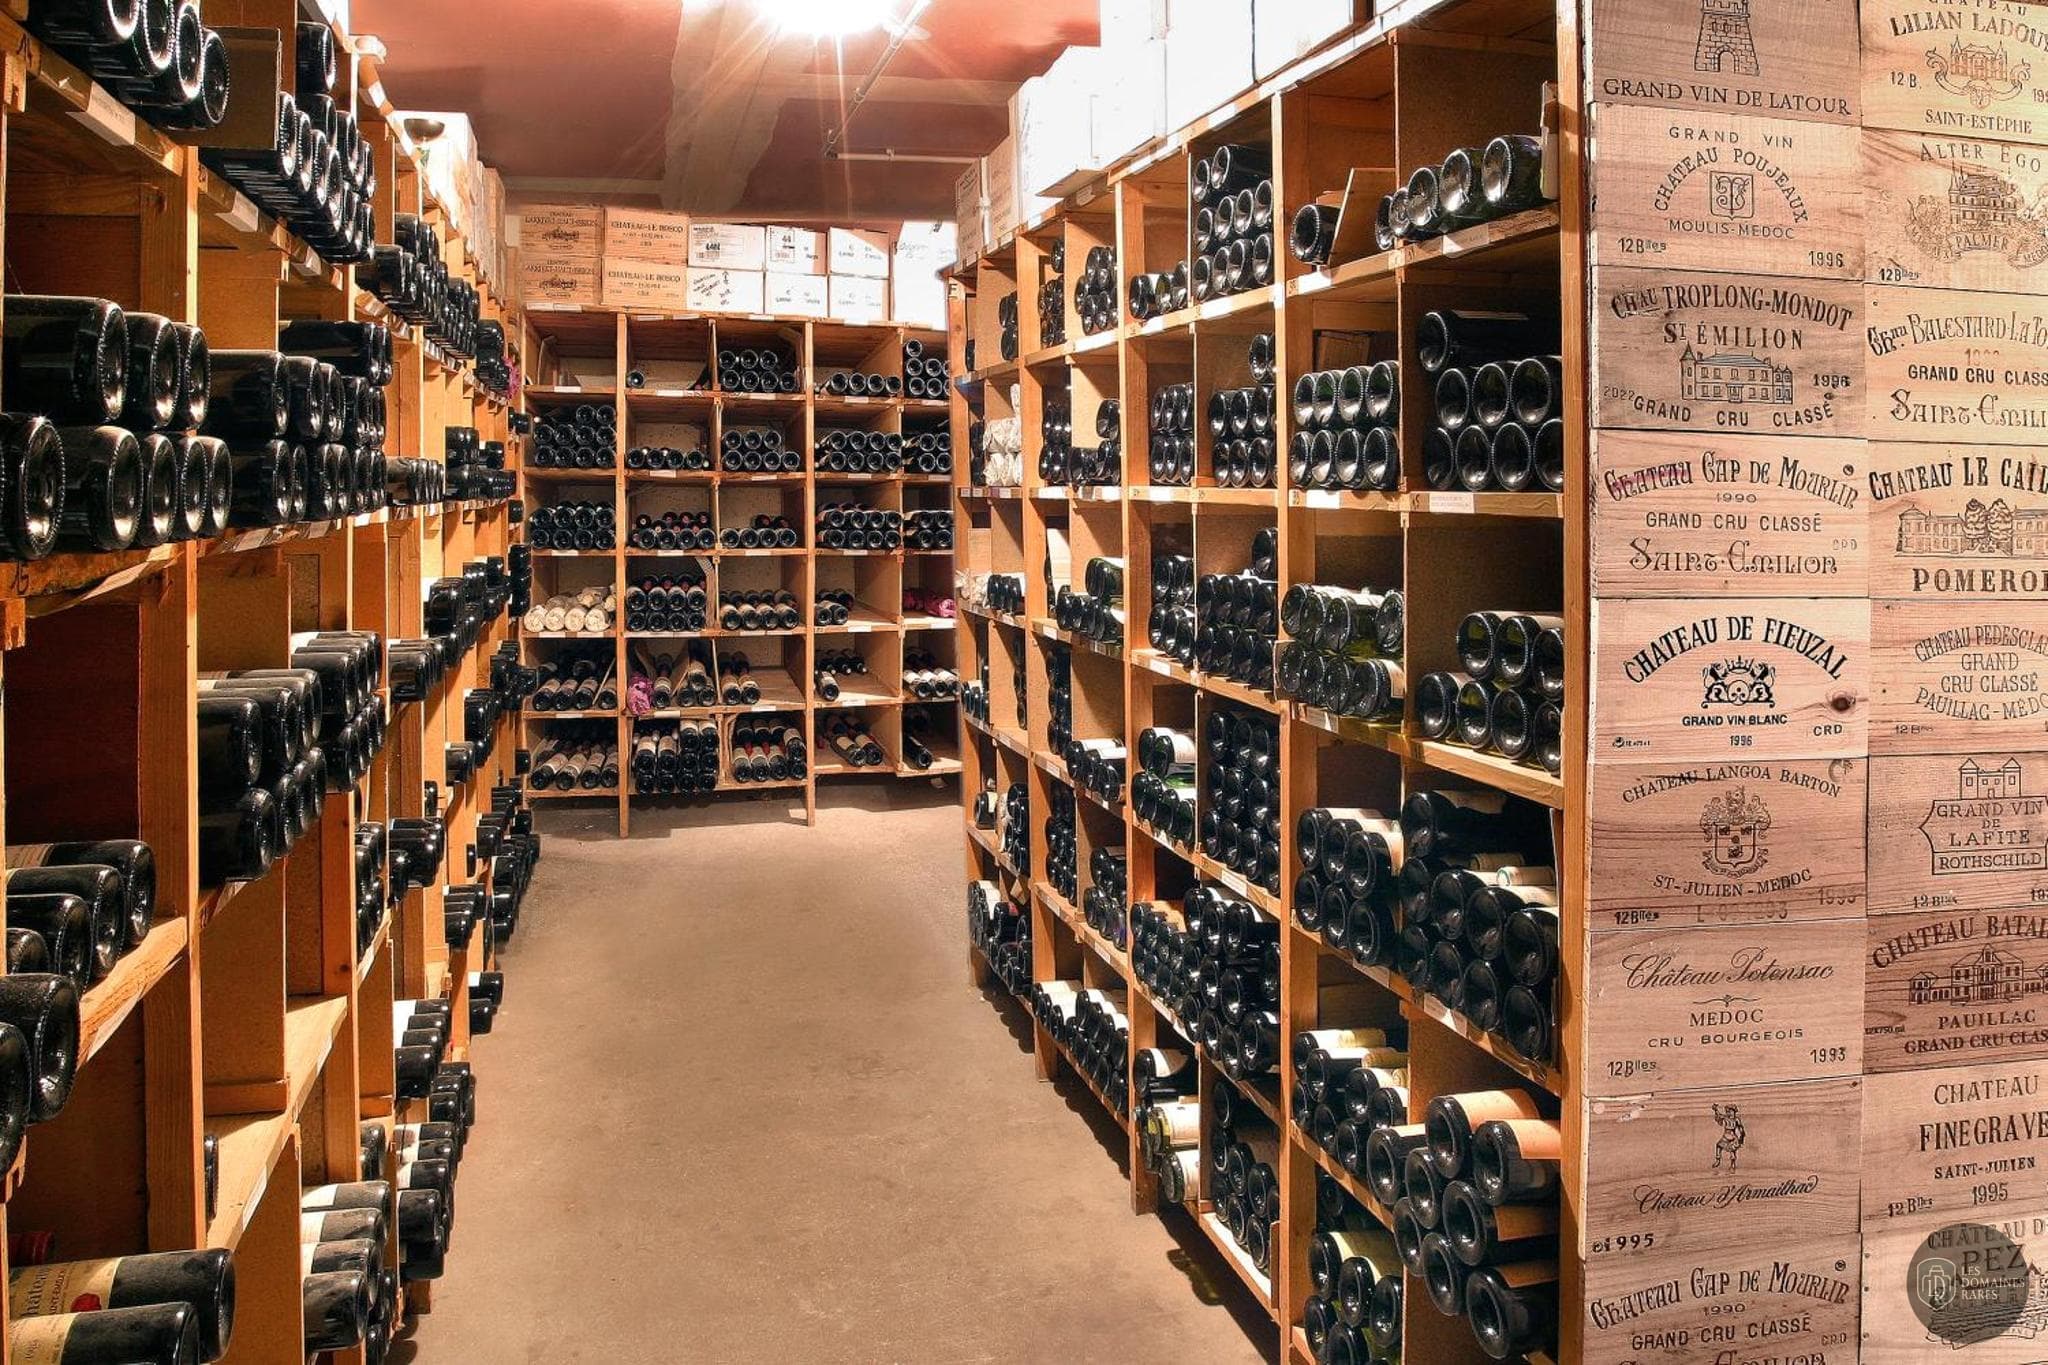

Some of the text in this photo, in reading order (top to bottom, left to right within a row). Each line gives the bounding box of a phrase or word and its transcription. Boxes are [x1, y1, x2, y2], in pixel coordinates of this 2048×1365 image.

[1890, 11, 1962, 36] LILIAN
[1603, 78, 1852, 115] GRAND VIN DE LATOUR
[1669, 126, 1793, 148] GRAND VIN
[1920, 142, 2041, 172] ALTER EGO
[1654, 147, 1809, 223] CHATEAU POUJEAUX
[1956, 234, 2009, 250] PALMER
[1808, 250, 1845, 268] 1996
[1663, 285, 1854, 331] TROPLONG-MONDOT
[1696, 321, 1802, 350] ÉMILION
[1908, 364, 1958, 382] GRAND
[1966, 367, 1995, 384] CRU
[1633, 395, 1834, 427] GRAND CRU CLASSÉ
[1702, 451, 1741, 483] CAP
[1750, 459, 1771, 484] DE
[1778, 456, 1859, 510] MOURLIN
[1868, 462, 1953, 501] CHATEAU
[1962, 457, 1988, 486] LE
[1716, 492, 1758, 504] 1990
[1646, 511, 1822, 532] GRAND CRU CLASSÉ
[1624, 616, 1848, 684] CHATEAU DE FIEUZAL
[1914, 627, 1971, 663] CHATEAU
[1961, 651, 2019, 671] GRAND
[1940, 674, 1974, 693] CRU
[1915, 686, 1990, 721] PAUILLAC
[1682, 714, 1788, 727] GRAND VIN BLANC
[1813, 724, 1843, 737] CRD
[1622, 766, 1841, 804] CHATEAU LANGOA BARTON
[1936, 800, 2043, 818] GRAND VIN
[1981, 818, 2001, 829] DE
[1949, 829, 2031, 847] LAFITE
[1939, 853, 2042, 870] ROTHSCHILD
[1652, 874, 1743, 897] ST-JULIEN
[1872, 917, 1975, 969] CHATEAU
[1621, 946, 1835, 989] Château Potensac
[1689, 1008, 1764, 1027] MEDOC
[1938, 1009, 2036, 1030] PAUILLAC
[1648, 1028, 1804, 1048] CRU BOURGEOIS
[1904, 1036, 1964, 1054] GRAND
[1969, 1032, 2004, 1048] CRU
[1810, 1047, 1846, 1064] 1993
[1933, 1075, 2039, 1105] CHATEAU
[1934, 1156, 2036, 1180] SAINT-JULIEN
[1633, 1184, 1713, 1215] Château
[1971, 1181, 2009, 1206] 1995
[1962, 1244, 2026, 1275] PEZ
[1690, 1267, 1731, 1299] CAP
[1738, 1269, 1761, 1294] DE
[1704, 1302, 1746, 1316] 1990
[1632, 1313, 1813, 1350] GRAND CRU CLASSÉ
